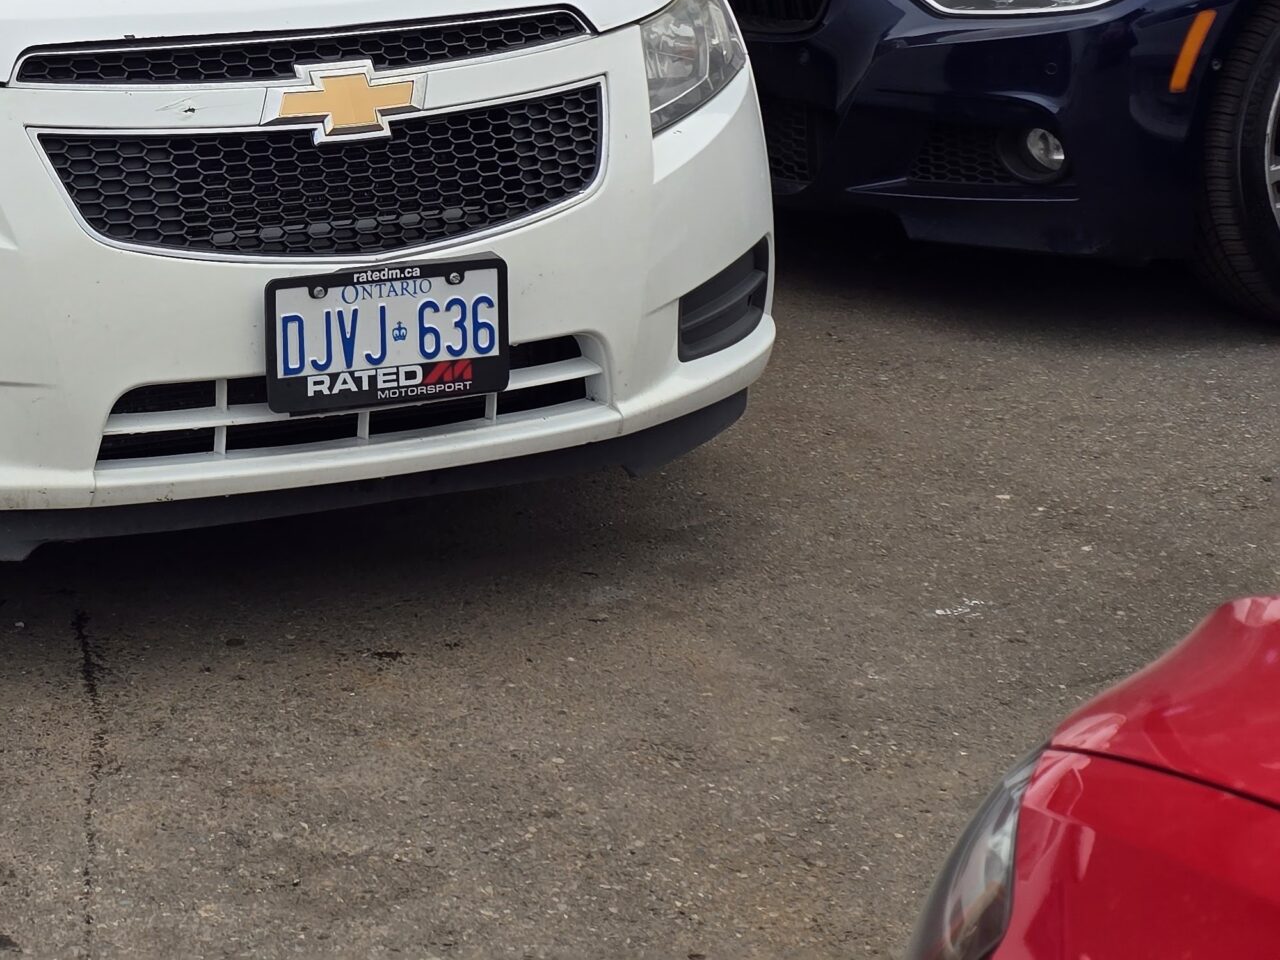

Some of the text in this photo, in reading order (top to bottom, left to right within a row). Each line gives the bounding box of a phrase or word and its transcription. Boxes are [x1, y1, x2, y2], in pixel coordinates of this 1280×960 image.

[353, 267, 421, 283] ratedm.ca
[341, 278, 432, 305] ONTARIO
[281, 294, 495, 377] DJVJ 636
[307, 364, 423, 397] RATED
[377, 381, 472, 400] MOTORSPORT
